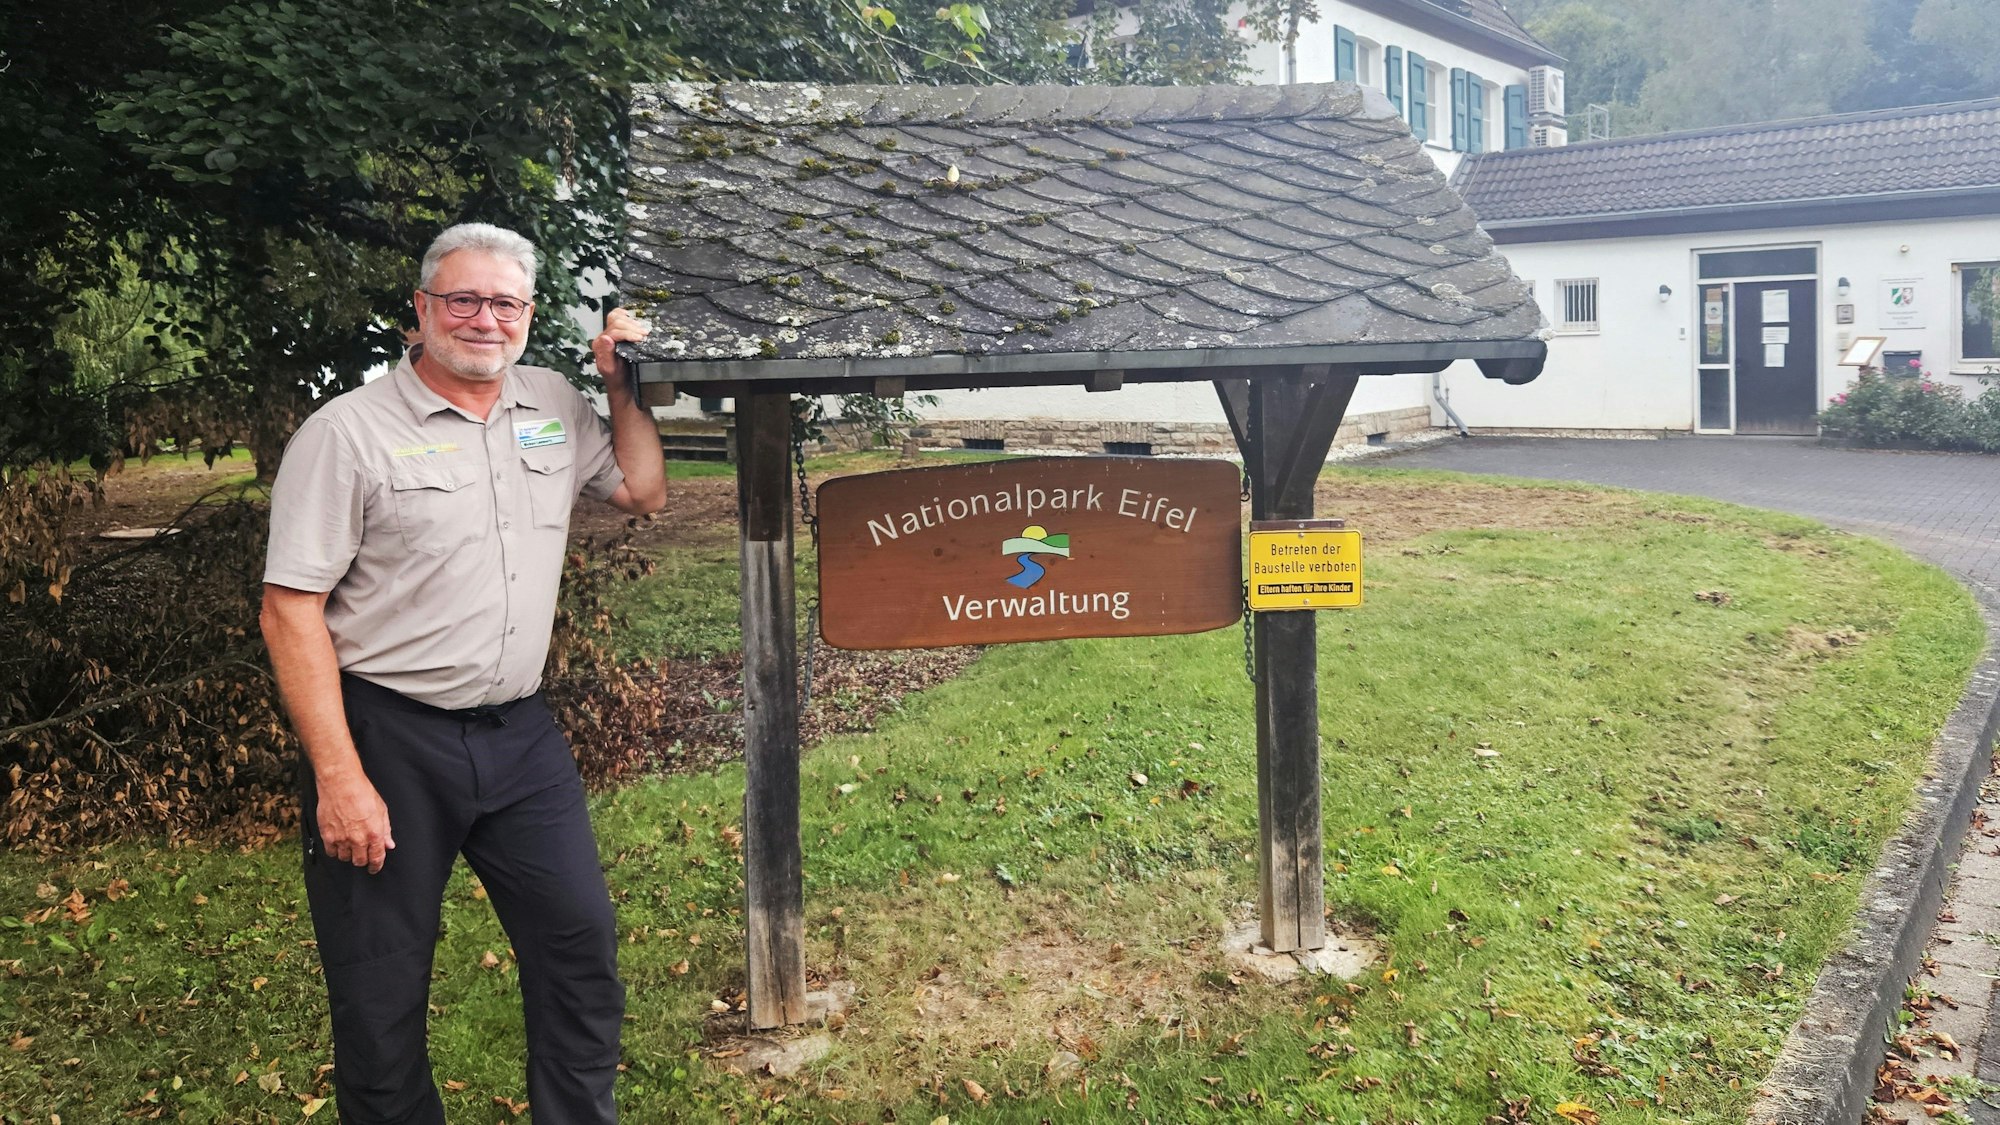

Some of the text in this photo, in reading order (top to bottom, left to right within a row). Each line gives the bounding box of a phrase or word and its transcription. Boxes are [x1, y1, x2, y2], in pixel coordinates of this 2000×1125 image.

[867, 483, 1198, 547] Nationalpark Eifel
[1271, 542, 1341, 556] Betreten der
[1254, 560, 1357, 574] Baustelle verboten
[1260, 585, 1280, 594] Eltern
[1280, 584, 1303, 593] haften
[1303, 583, 1313, 593] für
[1328, 583, 1351, 592] Kinder
[942, 589, 1130, 621] Verwaltung
